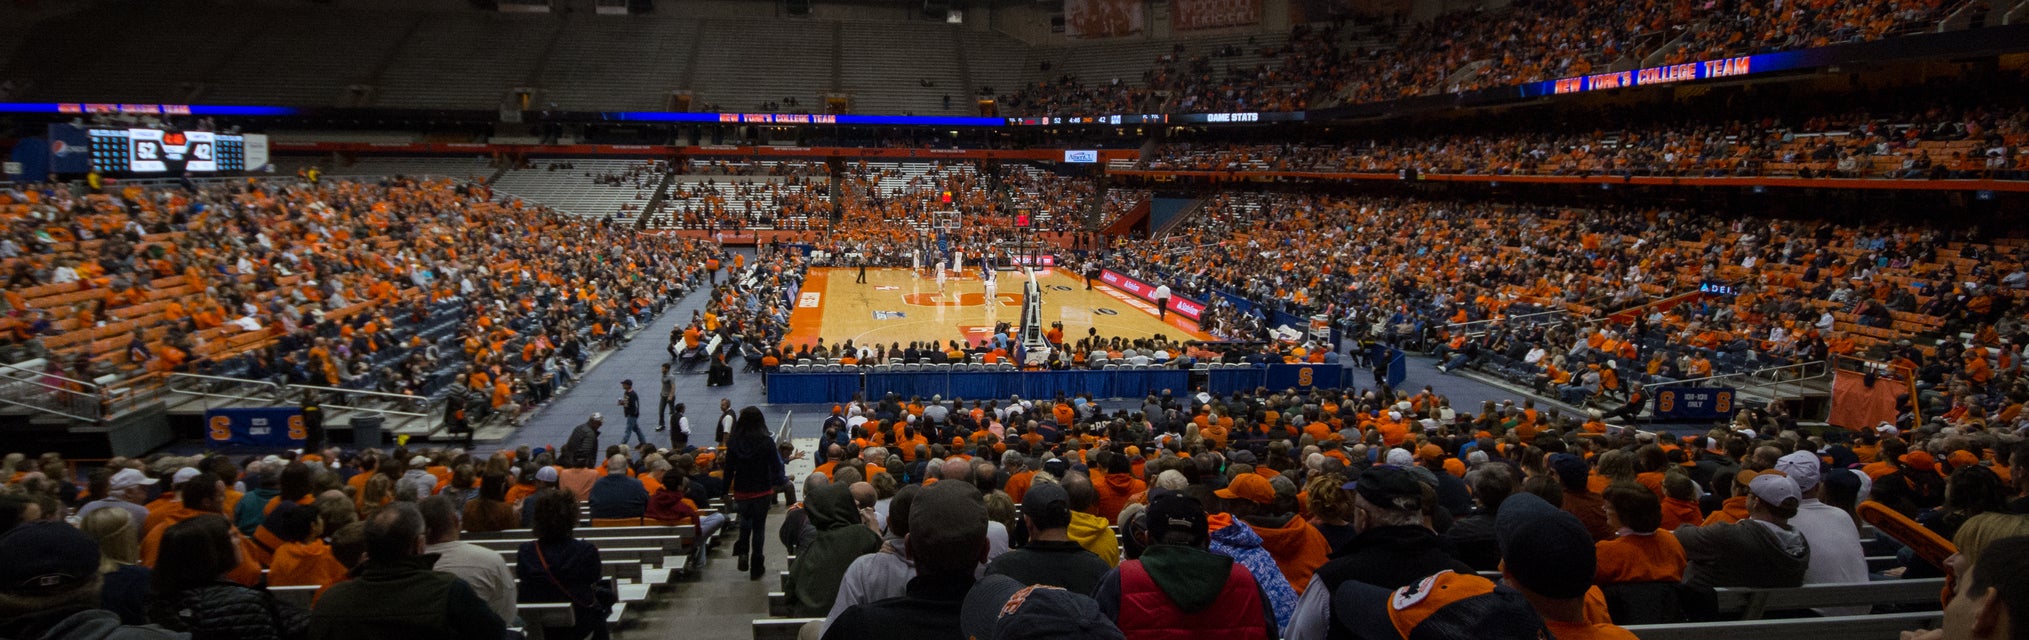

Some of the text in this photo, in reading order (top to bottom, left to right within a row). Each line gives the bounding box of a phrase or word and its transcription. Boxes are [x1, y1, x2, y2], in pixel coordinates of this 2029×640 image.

[1555, 56, 1750, 94] NEW YORK'S COLLEGE TEAM
[720, 113, 836, 123] NEW YORK'S COLLEGE TEAM
[1207, 112, 1259, 122] GAME STATS
[137, 142, 159, 160] 52
[193, 143, 212, 160] 42
[1299, 367, 1313, 386] S
